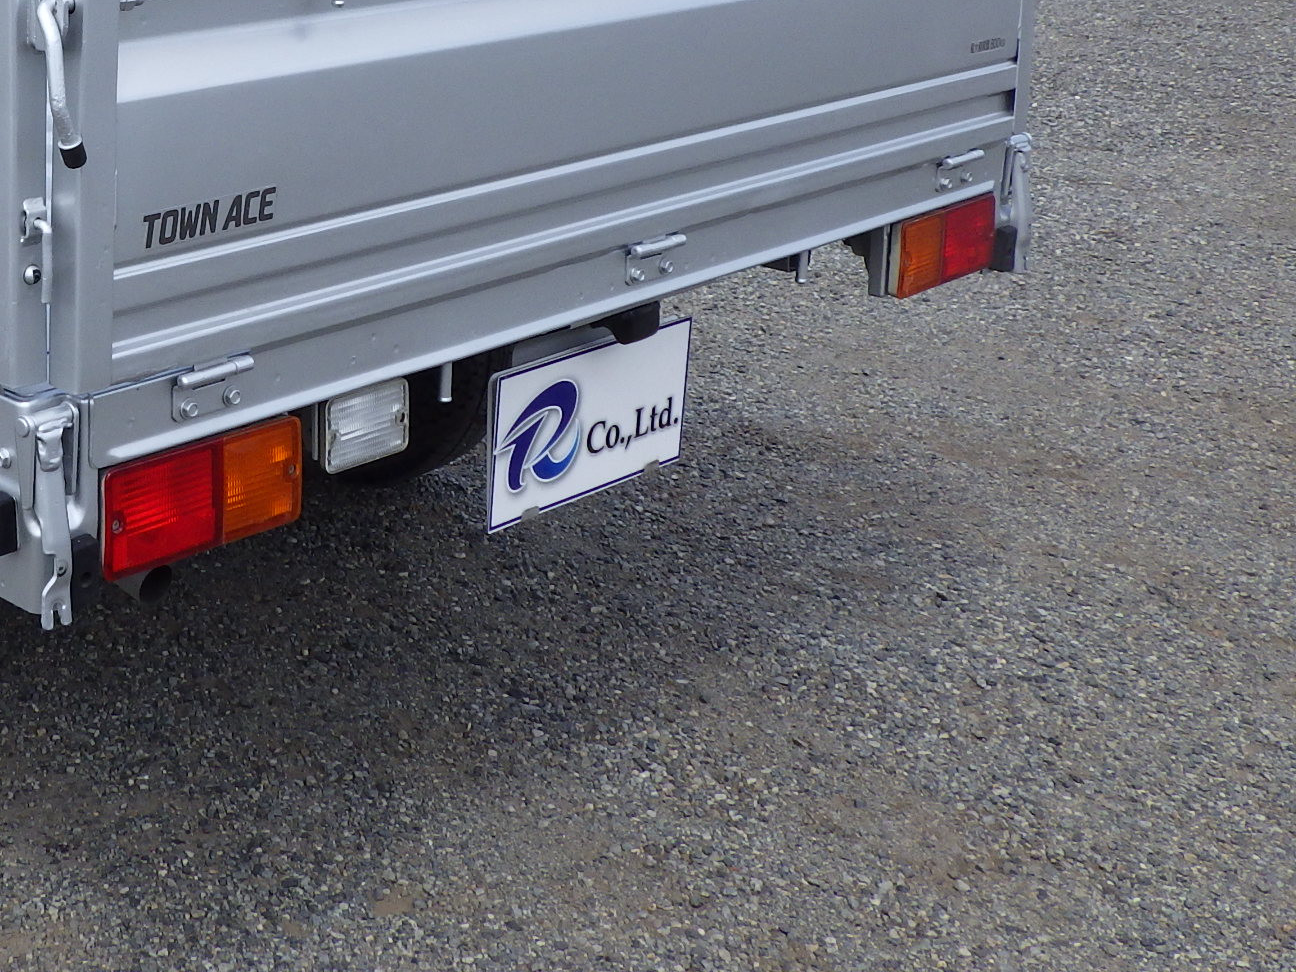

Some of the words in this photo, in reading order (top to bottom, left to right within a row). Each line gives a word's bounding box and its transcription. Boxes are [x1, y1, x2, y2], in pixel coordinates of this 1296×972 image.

[143, 199, 220, 249] TOWN
[222, 186, 277, 230] ACE
[586, 396, 679, 454] Co.,Ltd.
